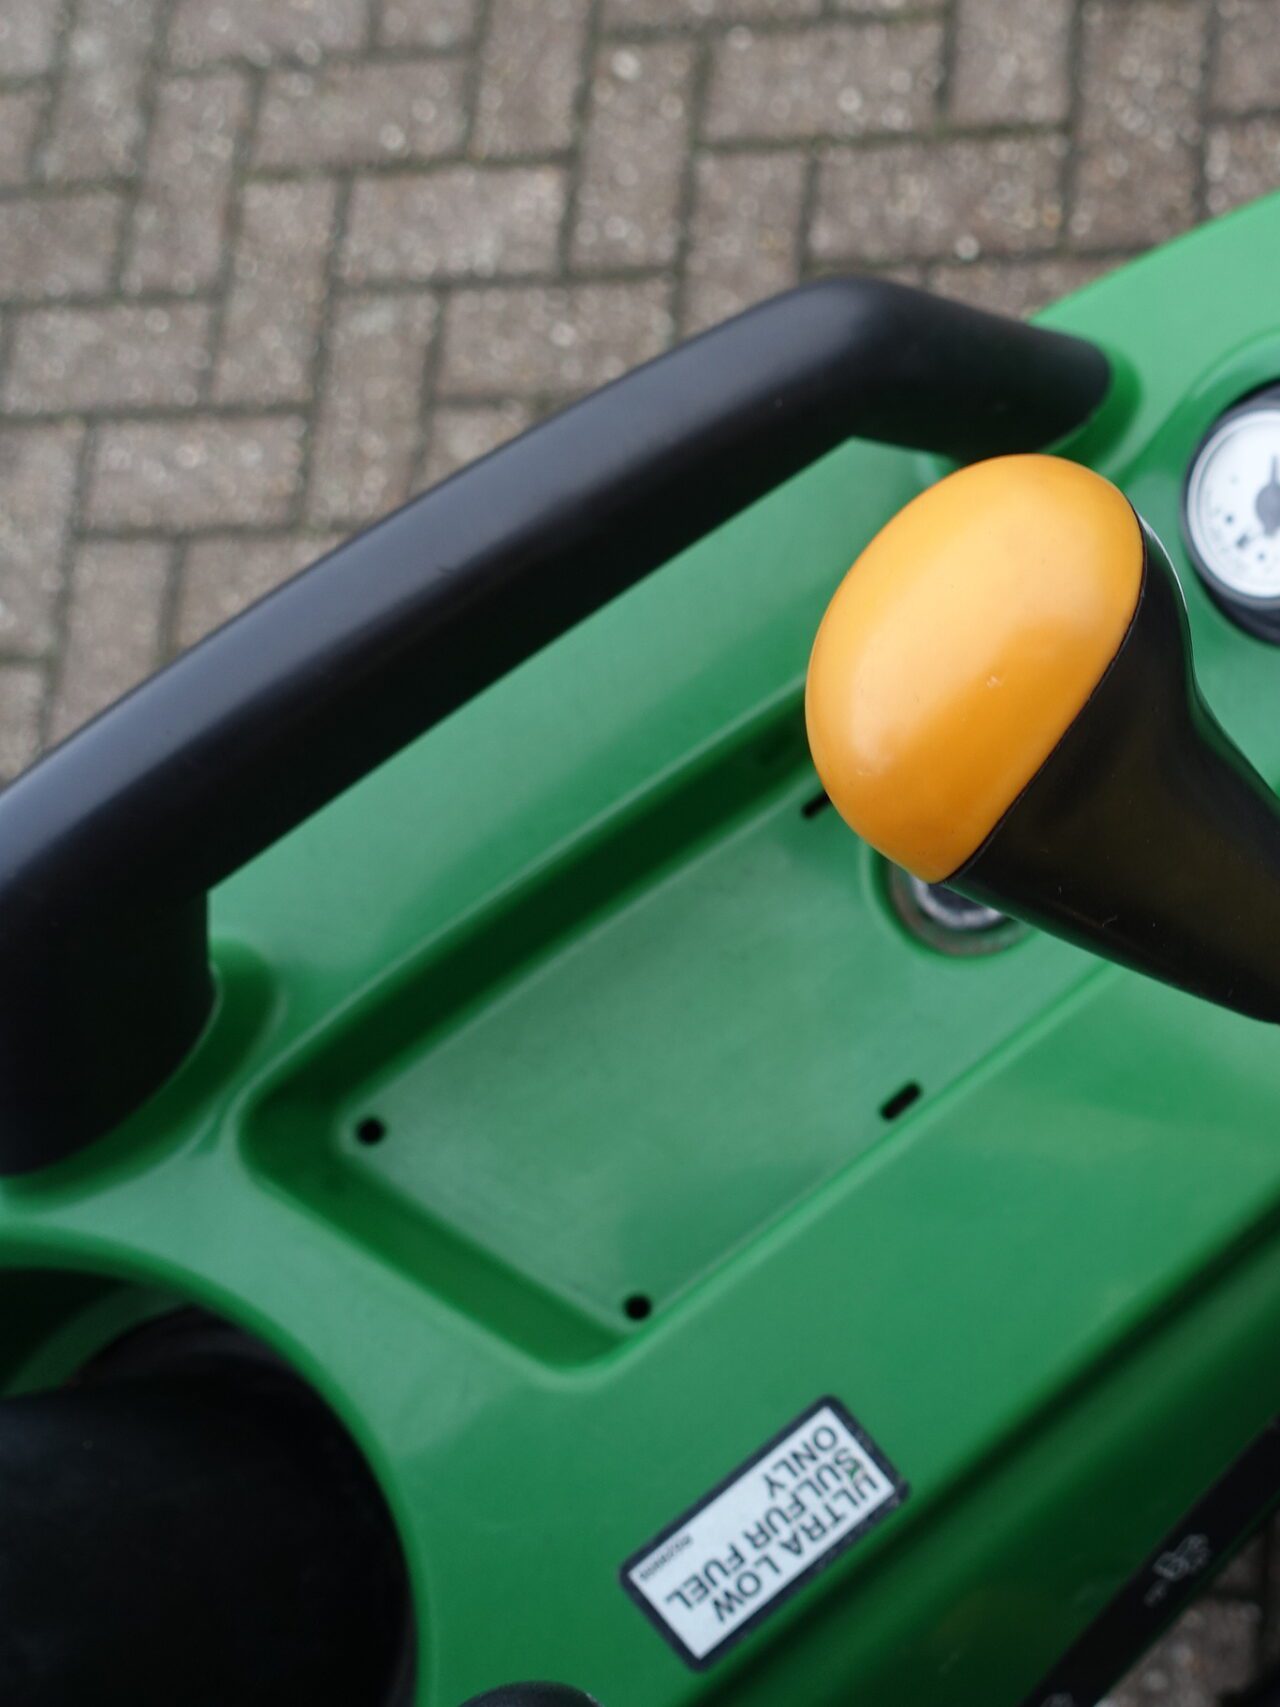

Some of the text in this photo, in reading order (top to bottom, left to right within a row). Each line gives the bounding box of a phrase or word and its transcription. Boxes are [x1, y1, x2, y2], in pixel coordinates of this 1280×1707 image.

[743, 1448, 863, 1549] SULFUR
[761, 1425, 837, 1499] ONLY
[779, 1472, 880, 1557] ULTRA
[665, 1543, 746, 1610] FUEL
[710, 1554, 782, 1622] LOW
